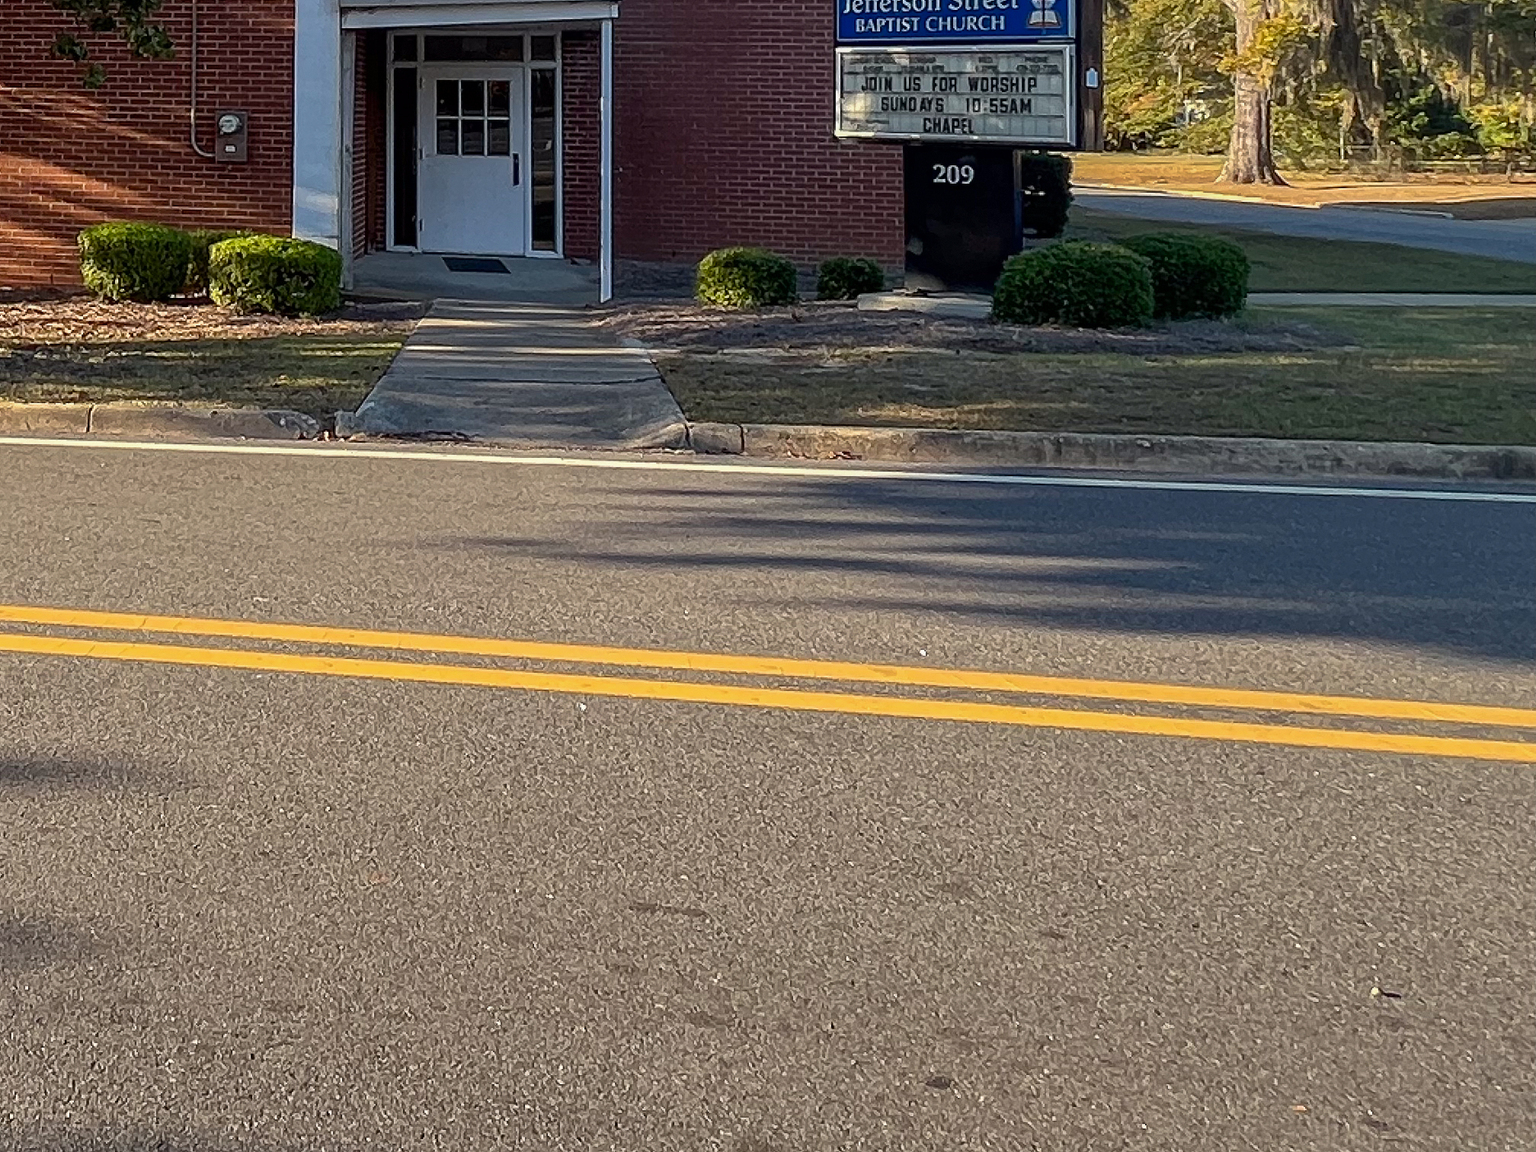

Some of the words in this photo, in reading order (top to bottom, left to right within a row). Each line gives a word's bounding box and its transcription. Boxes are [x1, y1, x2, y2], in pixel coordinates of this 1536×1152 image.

[855, 16, 921, 33] BAPTIST
[925, 15, 1005, 32] CHURCH
[861, 76, 892, 92] JOIN
[903, 77, 921, 92] US
[932, 77, 957, 92] FOR
[968, 77, 1037, 93] WORSHIP
[880, 97, 944, 112] SUNDAYS
[966, 98, 1032, 114] 10:55AM
[923, 117, 974, 134] CHAPEL
[932, 164, 974, 185] 209
